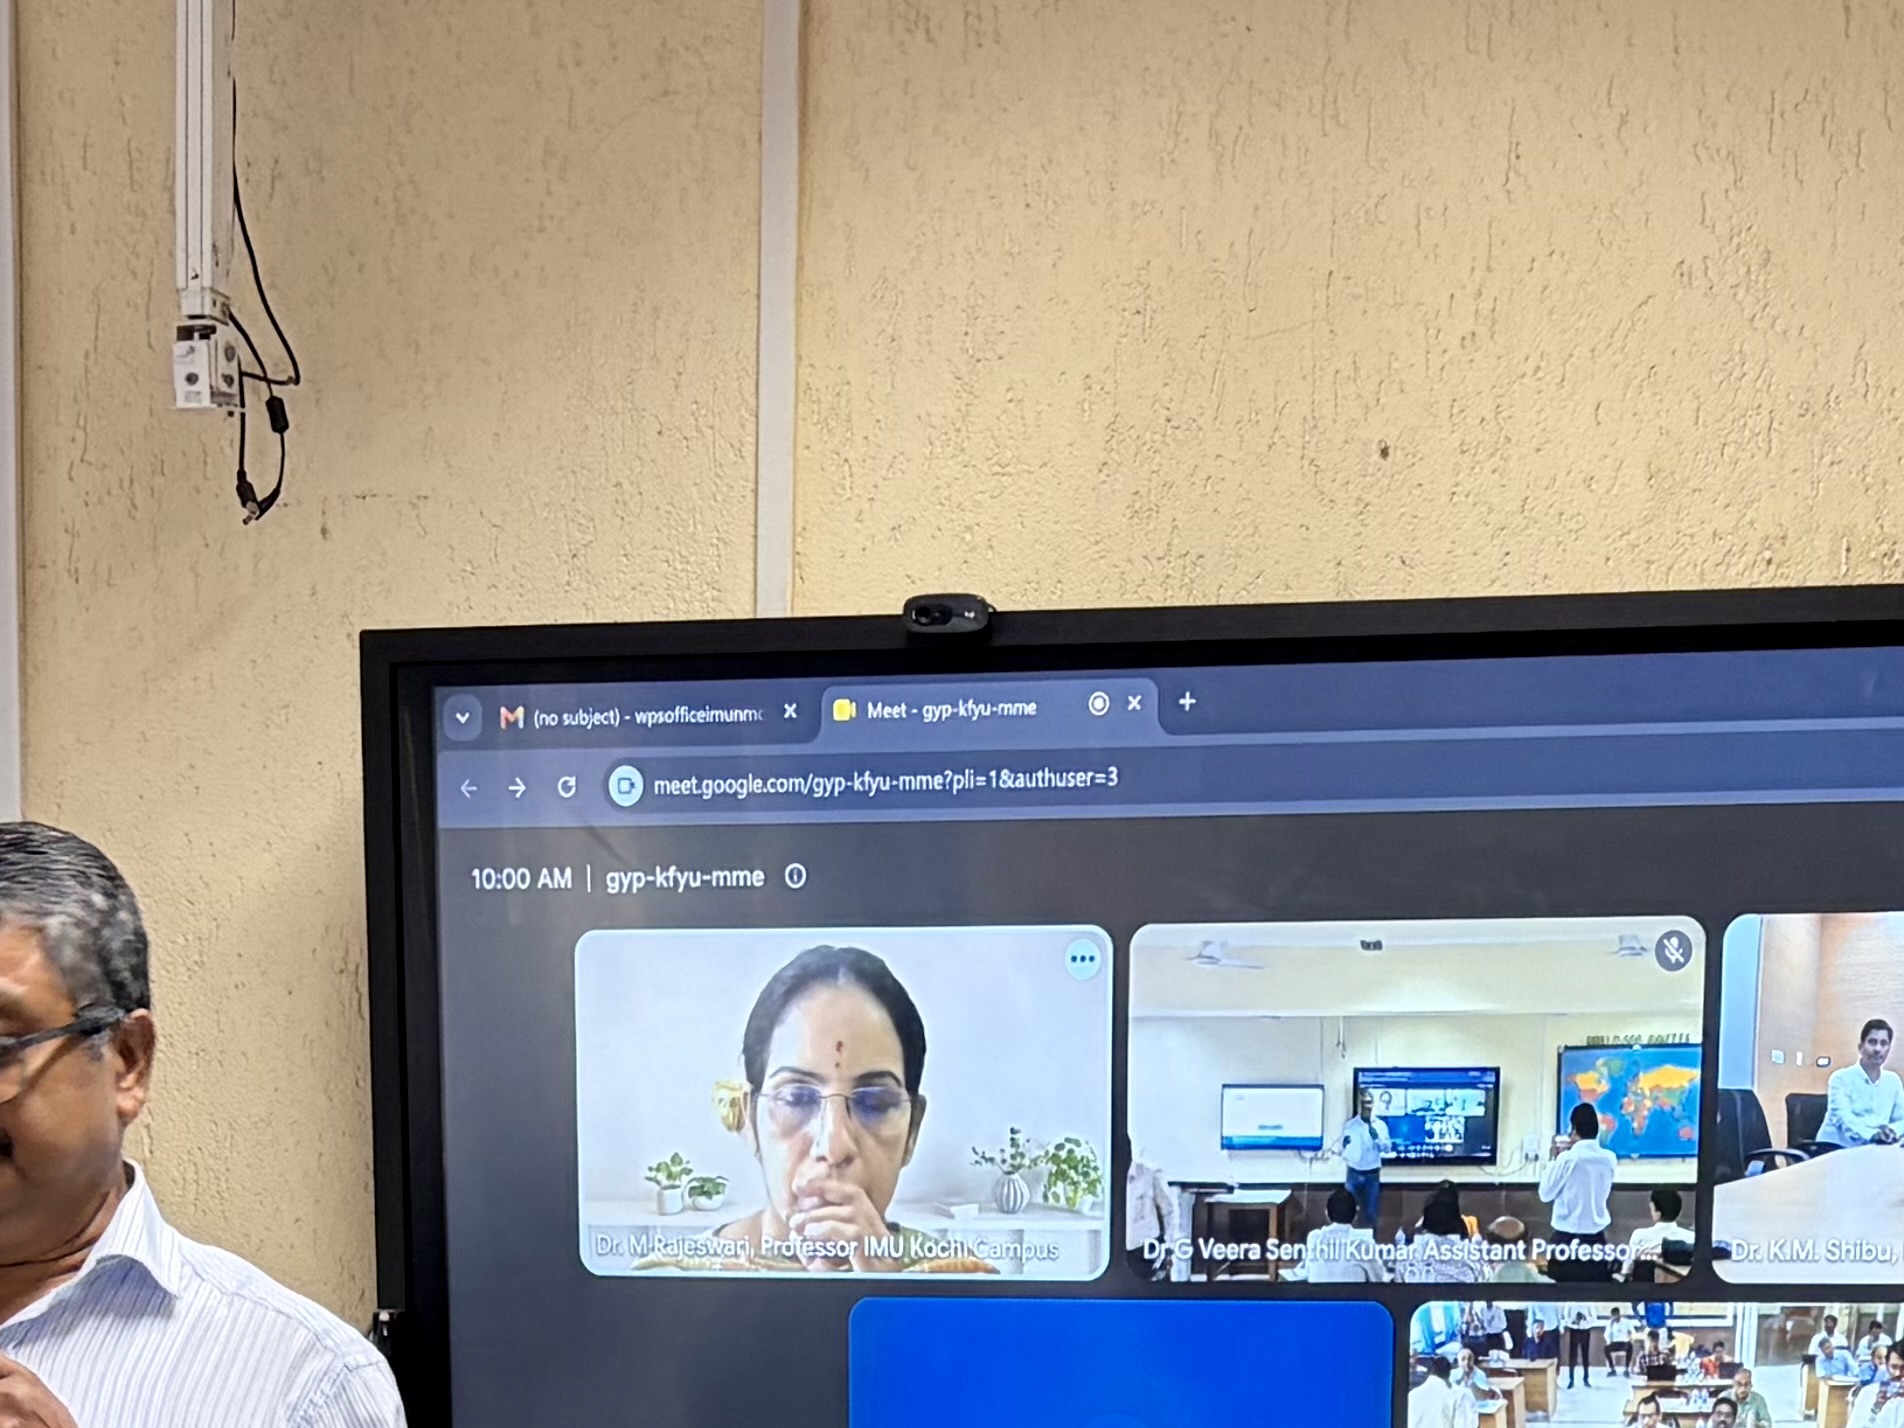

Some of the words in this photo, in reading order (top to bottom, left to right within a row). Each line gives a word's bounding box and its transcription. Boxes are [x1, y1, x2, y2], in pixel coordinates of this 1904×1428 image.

[533, 707, 560, 730] (no
[563, 706, 620, 732] subject)
[867, 702, 907, 720] Meet
[922, 700, 1037, 722] gyp-kfyu-mme
[471, 867, 531, 890] 10:00
[537, 867, 573, 890] AM
[606, 865, 765, 893] gyp-kfyu-mme
[597, 1234, 624, 1255] Dr.
[761, 1235, 858, 1257] Professor
[864, 1236, 904, 1257] IMU
[975, 1238, 1060, 1263] Campus
[1198, 1238, 1261, 1260] Veera
[1423, 1238, 1526, 1261] Assistant
[1731, 1239, 1763, 1261] Dr.
[1769, 1239, 1820, 1261] K.M.
[1826, 1239, 1898, 1265] Shibu,
